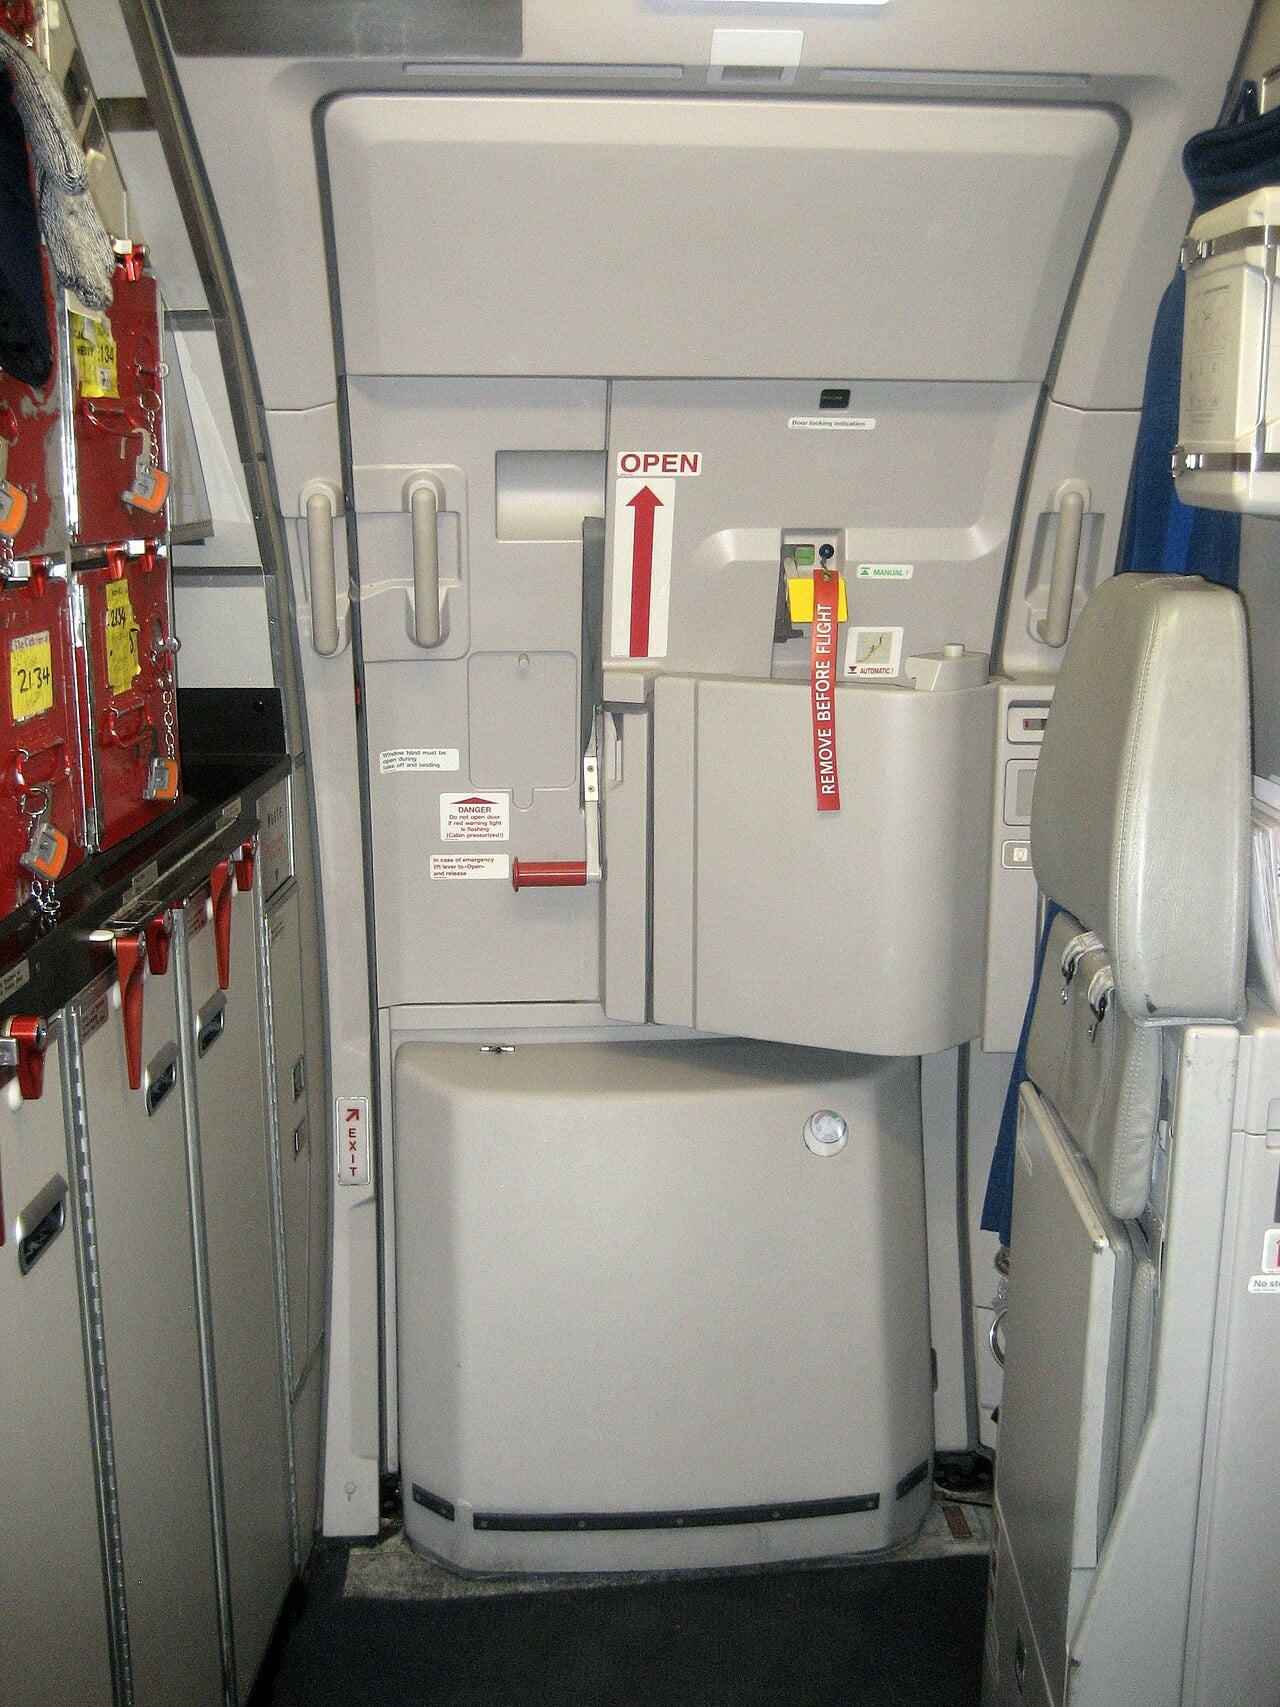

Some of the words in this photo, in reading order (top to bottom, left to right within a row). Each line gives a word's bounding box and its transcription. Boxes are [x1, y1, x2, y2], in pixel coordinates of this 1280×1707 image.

[809, 419, 833, 427] locking
[620, 453, 698, 473] OPEN
[873, 568, 904, 576] MANUAL
[816, 603, 832, 654] FLIGHT
[17, 666, 50, 693] 2134
[860, 667, 890, 675] AUTOMATIC
[816, 660, 831, 721] BEFORE
[818, 728, 836, 794] REMOVE
[348, 1127, 357, 1177] EXIT
[1253, 1279, 1267, 1287] No
